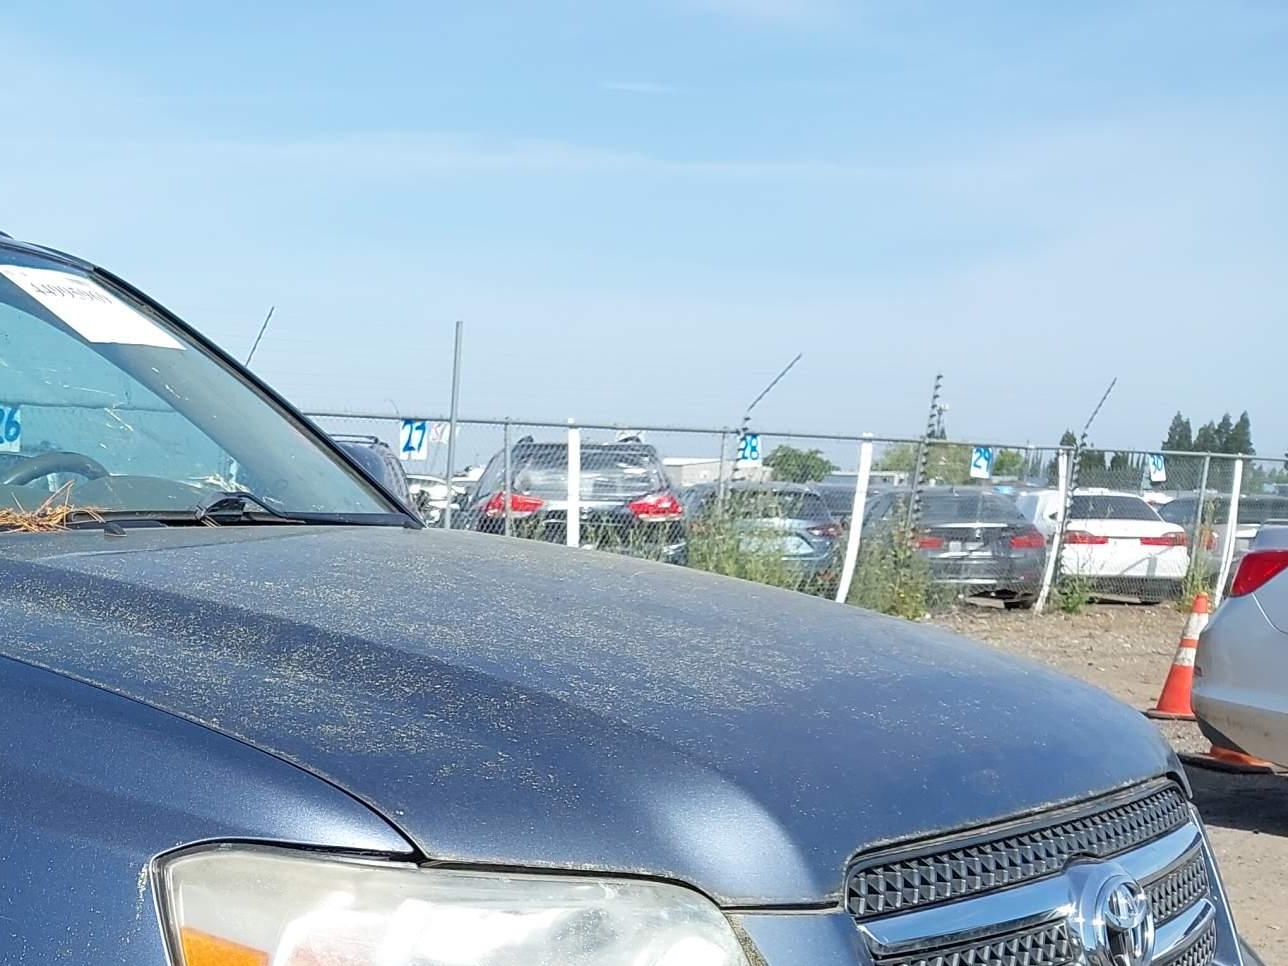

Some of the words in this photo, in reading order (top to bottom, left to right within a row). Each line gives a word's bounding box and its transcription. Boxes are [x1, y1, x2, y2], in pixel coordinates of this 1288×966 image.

[402, 420, 426, 453] 27
[741, 433, 760, 461] 28
[972, 447, 991, 473] 29
